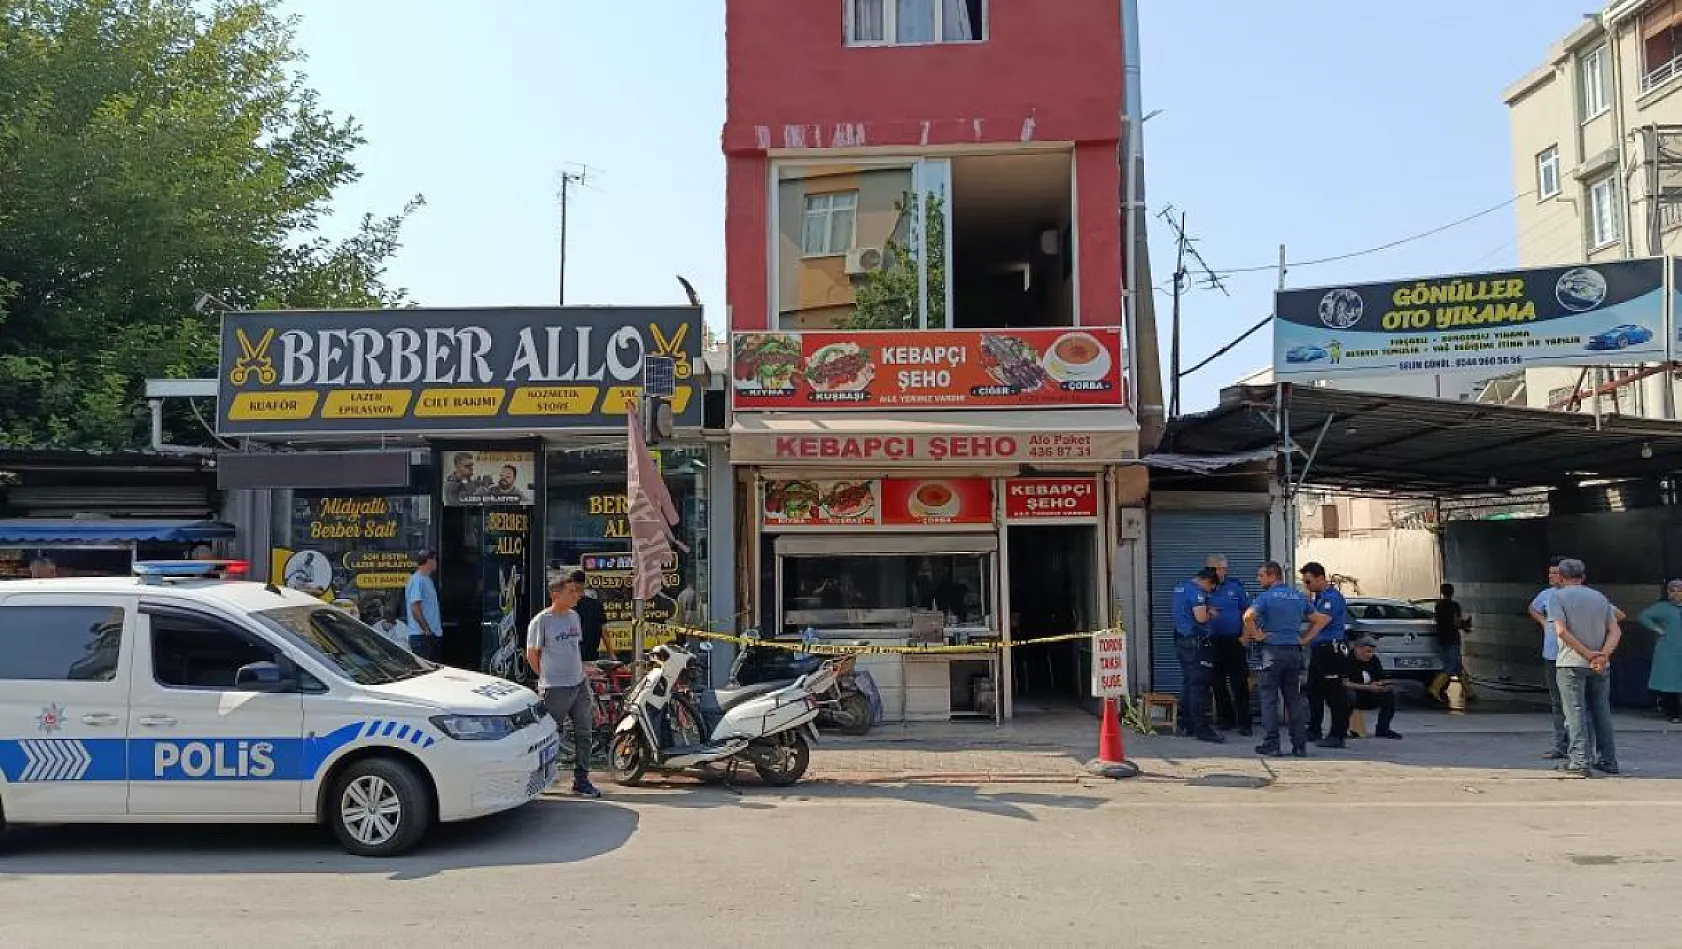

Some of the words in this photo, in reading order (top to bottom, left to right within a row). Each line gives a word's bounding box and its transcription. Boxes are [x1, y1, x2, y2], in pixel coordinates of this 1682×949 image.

[1392, 278, 1524, 306] GÖNÜLLER
[1381, 308, 1431, 330] OTO
[1435, 301, 1536, 328] YIKAMA
[279, 327, 494, 386] BERBER
[505, 326, 645, 382] ALLO
[881, 346, 967, 367] KEBAPÇI
[898, 369, 951, 391] ŞEHO
[1068, 381, 1104, 391] ÇORBA
[350, 391, 383, 402] LAZER
[249, 400, 297, 412] KUAFÖR
[537, 402, 569, 412] STORE
[1029, 435, 1050, 445] Alo
[1053, 435, 1091, 445] Paket
[775, 436, 914, 460] KEBAPÇI
[928, 436, 1017, 461] ŞEHO
[1028, 447, 1053, 457] 436
[1057, 446, 1074, 457] 87
[1011, 483, 1091, 497] KEBAPÇI
[1027, 498, 1077, 510] ŞEHO
[311, 521, 361, 538] Berber
[365, 520, 398, 538] Sait
[496, 536, 522, 554] ALLO
